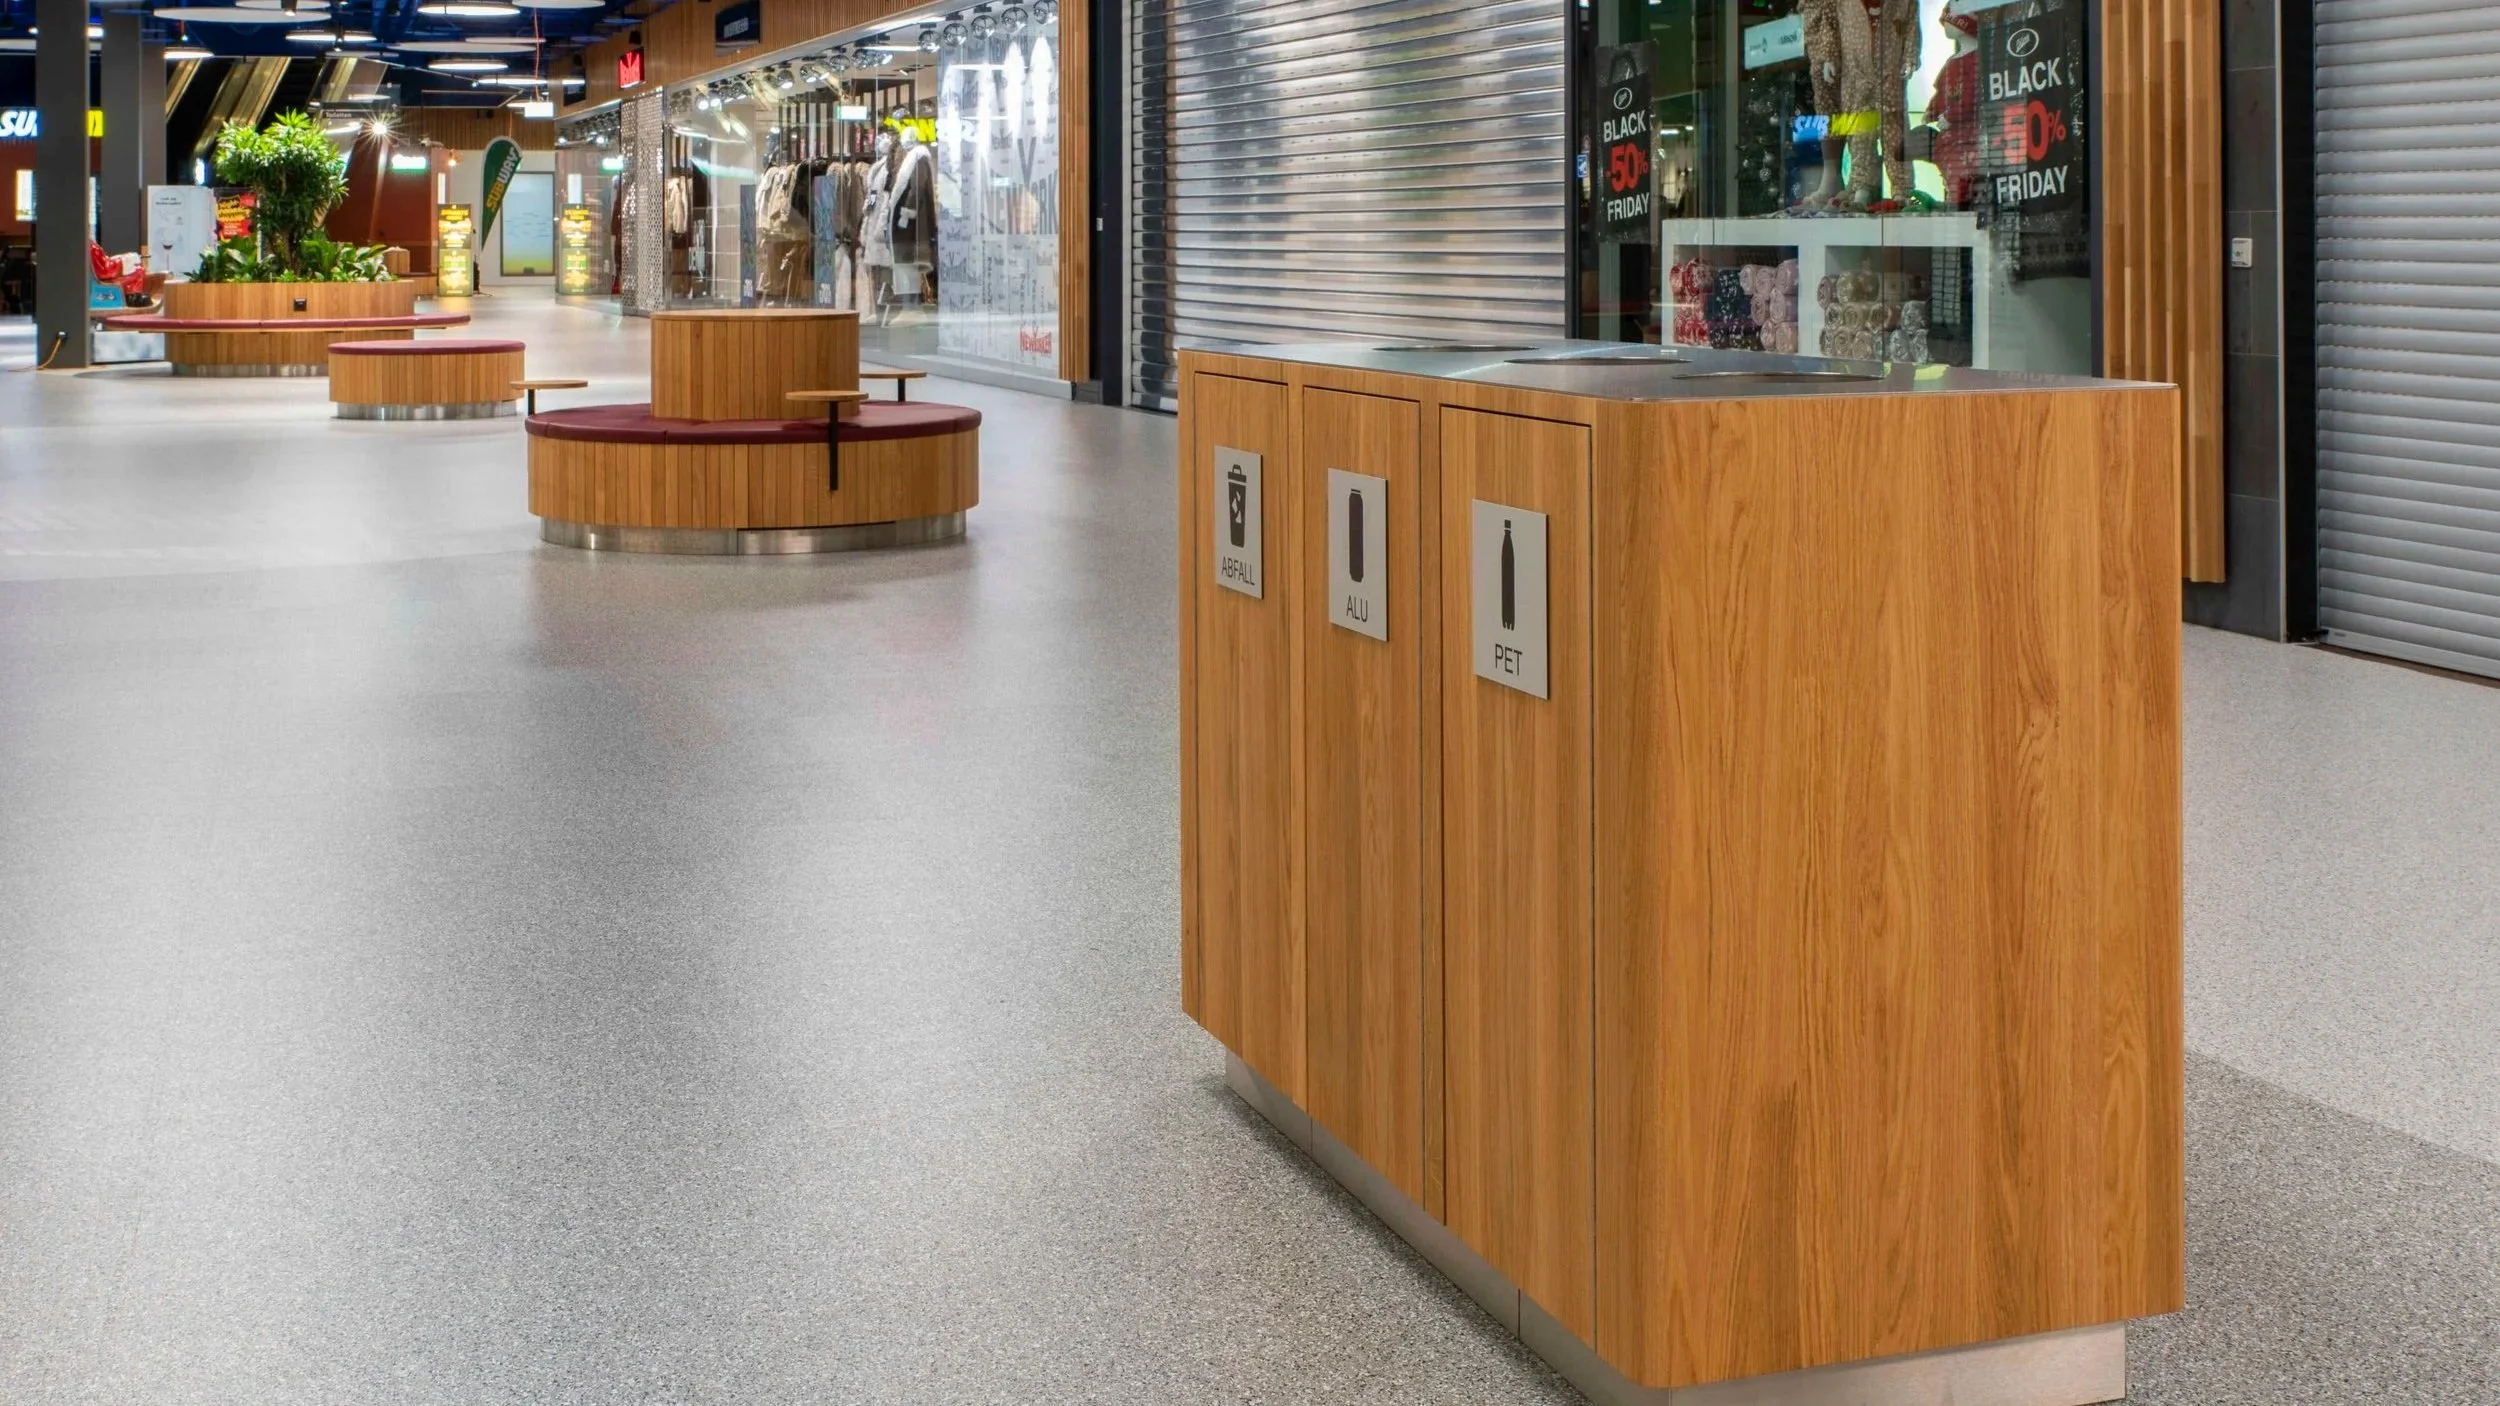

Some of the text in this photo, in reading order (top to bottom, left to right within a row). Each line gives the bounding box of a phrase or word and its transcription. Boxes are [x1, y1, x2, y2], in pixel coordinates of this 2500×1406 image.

[1989, 57, 2063, 101] BLACK
[1603, 109, 1647, 143] BLACK
[1992, 100, 2068, 165] -50%
[486, 146, 520, 213] SUBWAY
[1604, 142, 1650, 193] -50%
[1996, 165, 2069, 204] FRIDAY
[1606, 192, 1650, 222] FRIDAY
[1221, 556, 1255, 586] ABFALL
[1346, 595, 1368, 624] ALU
[1494, 643, 1523, 677] PET
